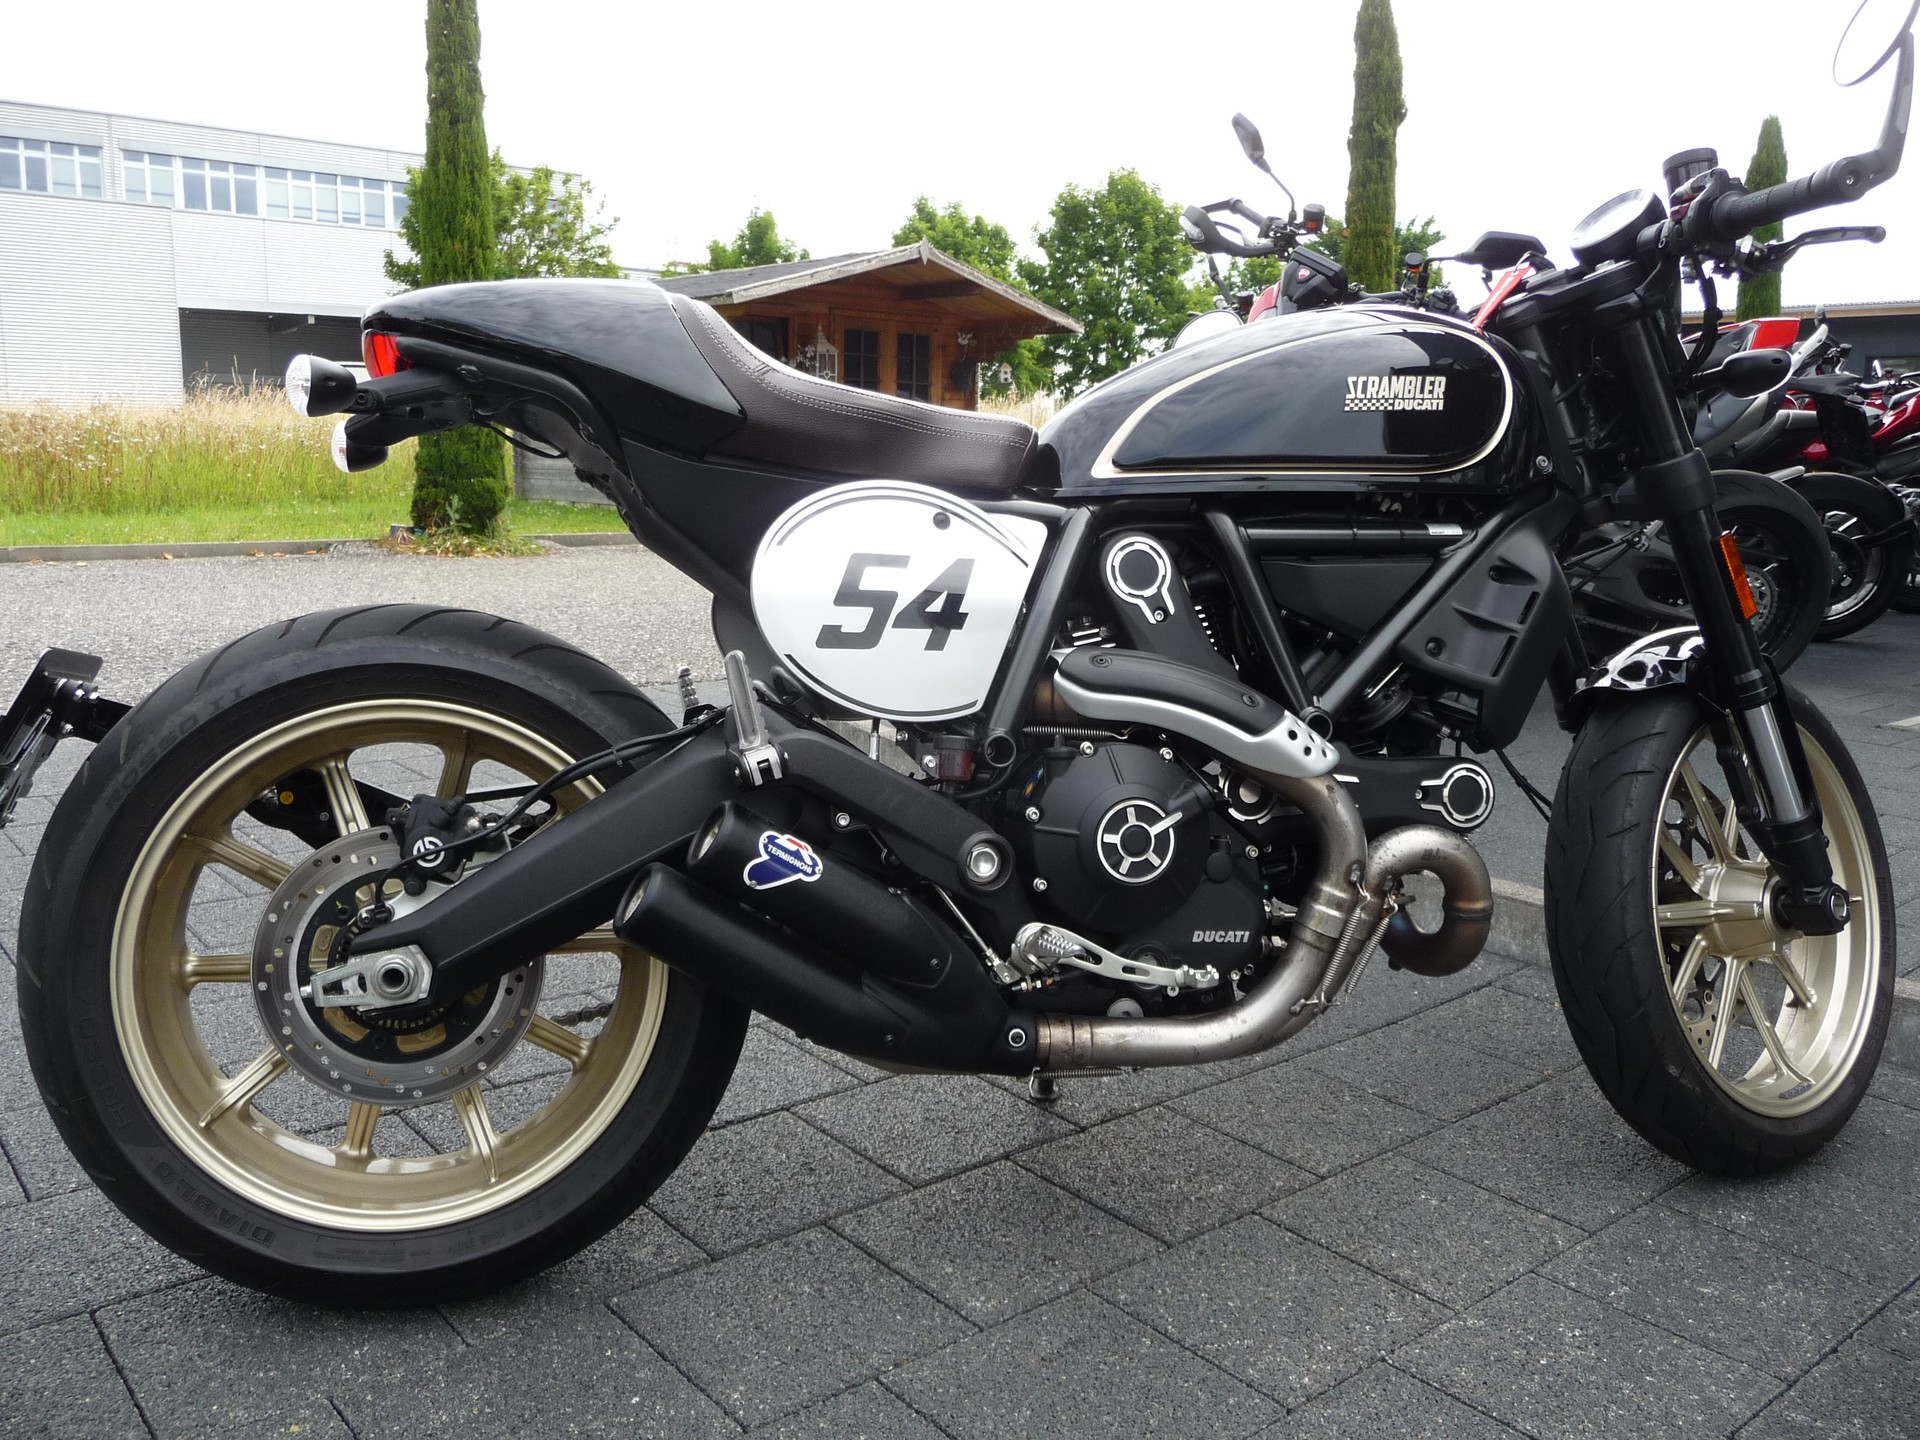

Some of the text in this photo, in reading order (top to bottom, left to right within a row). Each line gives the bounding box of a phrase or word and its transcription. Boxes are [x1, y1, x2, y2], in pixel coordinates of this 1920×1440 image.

[1345, 375, 1447, 399] SCRAMBLER
[1393, 399, 1444, 411] DUCATI
[815, 552, 976, 652] 54
[767, 844, 813, 875] TERMIGNONI
[1192, 930, 1250, 943] DUCATI
[154, 1161, 276, 1248] DIABLO
